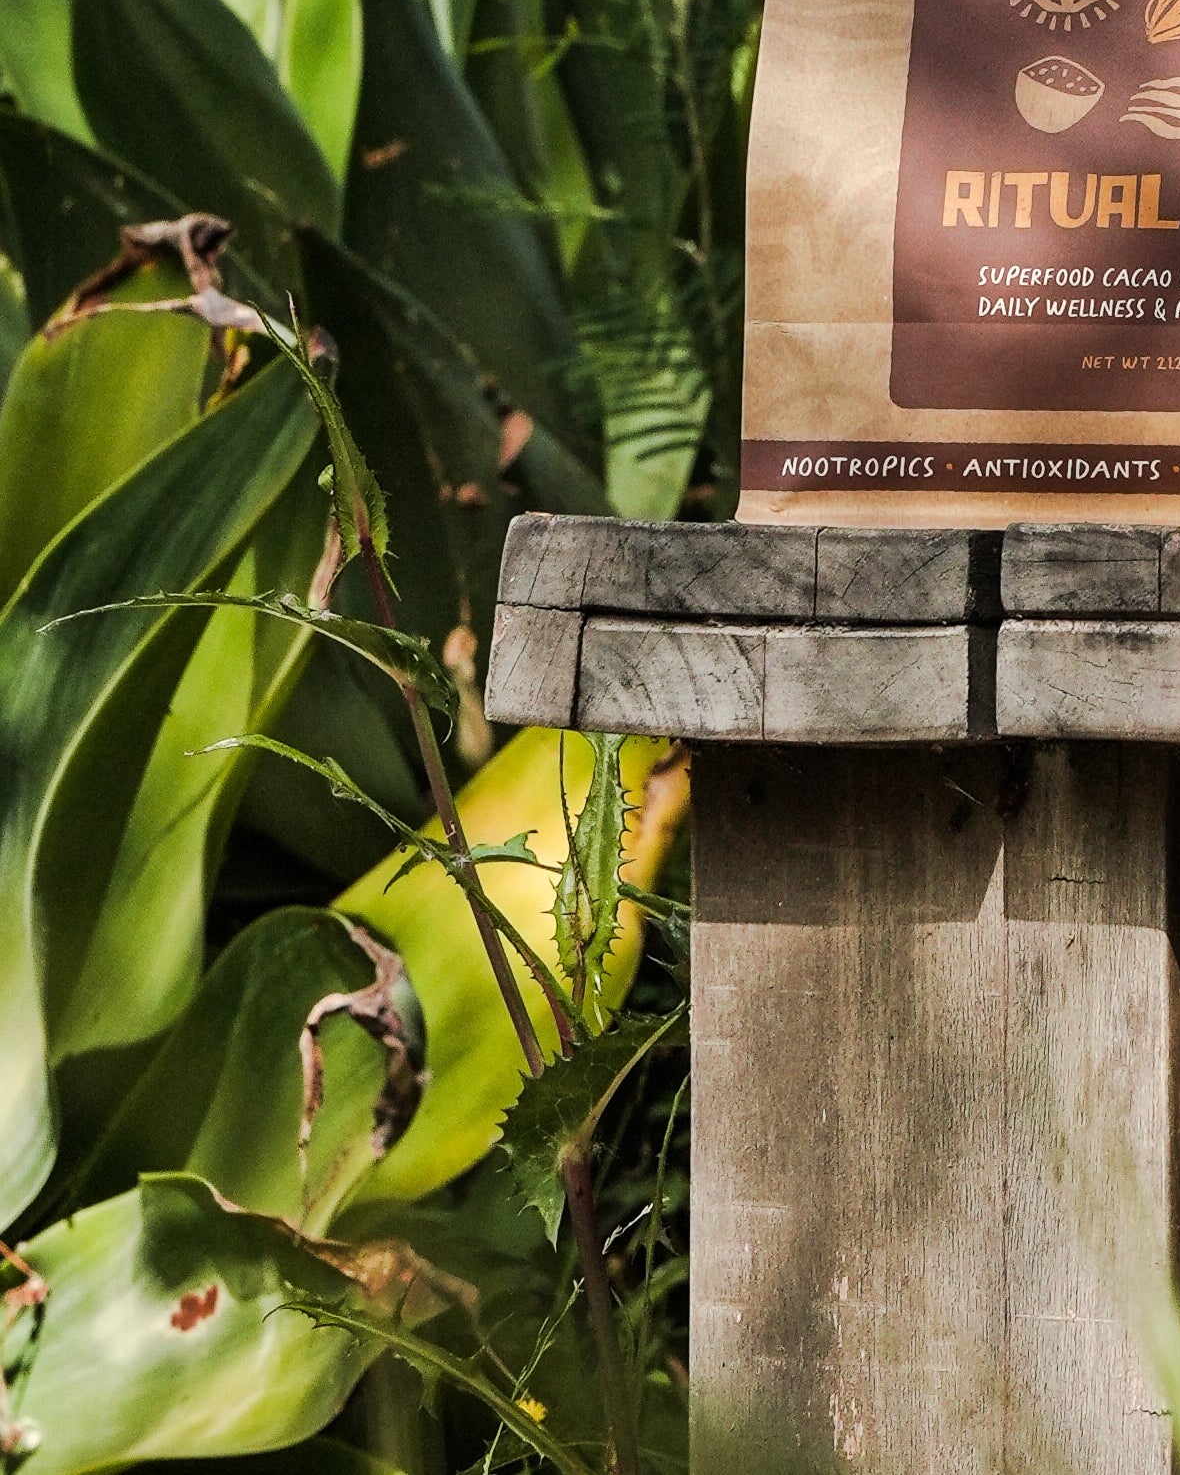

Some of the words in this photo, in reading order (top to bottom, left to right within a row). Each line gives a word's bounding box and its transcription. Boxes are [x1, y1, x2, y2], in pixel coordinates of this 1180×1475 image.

[942, 170, 1180, 229] RITUAL
[978, 265, 1095, 287] SUPERFOOD
[1102, 268, 1172, 288] CACAO
[978, 297, 1040, 318] DAILY
[1046, 298, 1146, 320] WELLNESS
[1154, 299, 1168, 321] &
[1082, 356, 1114, 369] NET
[1122, 356, 1150, 370] WT
[781, 455, 935, 477] NOOTROPICS
[963, 458, 1161, 481] ANTIOXIDANTS
